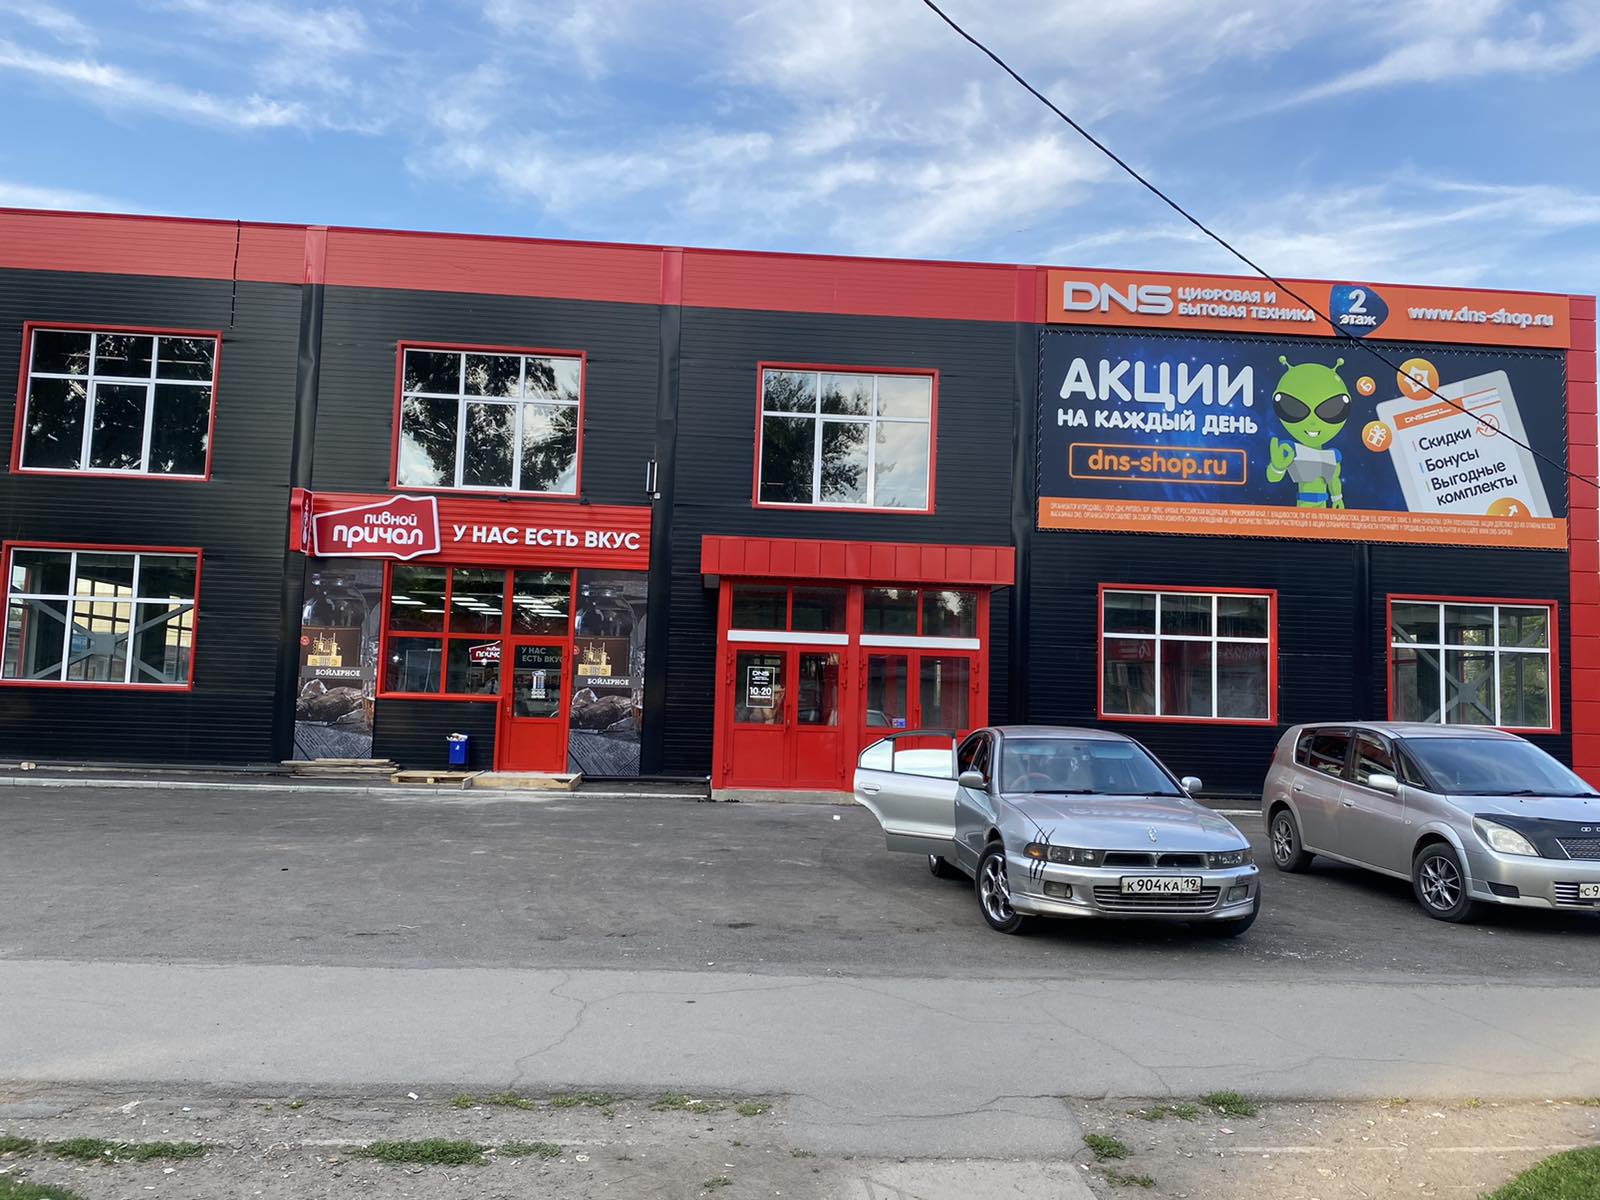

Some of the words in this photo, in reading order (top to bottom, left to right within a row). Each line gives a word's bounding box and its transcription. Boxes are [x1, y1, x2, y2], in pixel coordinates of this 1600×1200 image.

[1063, 281, 1174, 315] DNS
[1177, 287, 1261, 305] ЦИФРОВАЯ
[1264, 291, 1276, 304] И
[1349, 289, 1367, 313] 2
[1178, 303, 1247, 318] БЫТОВАЯ
[1250, 306, 1316, 322] ТЕХНИКА
[1339, 313, 1377, 326] этаж
[1408, 306, 1554, 328] www.dns-shop.ru
[1059, 357, 1254, 412] АКЦИИ
[1057, 408, 1088, 427] НА
[1095, 409, 1196, 434] КАЖДЫЙ
[1202, 414, 1258, 436] ДЕНЬ
[1418, 428, 1472, 451] Скидки
[1088, 449, 1227, 479] dns-shop.ru
[1425, 449, 1480, 472] Бонусы
[1430, 461, 1507, 491] Выгодные
[1436, 474, 1518, 506] комплекты
[364, 511, 417, 526] пивной
[332, 525, 424, 548] причал
[453, 525, 467, 542] У
[472, 526, 519, 544] НАС
[525, 528, 579, 547] ЕСТЬ
[584, 530, 641, 550] ВКУС
